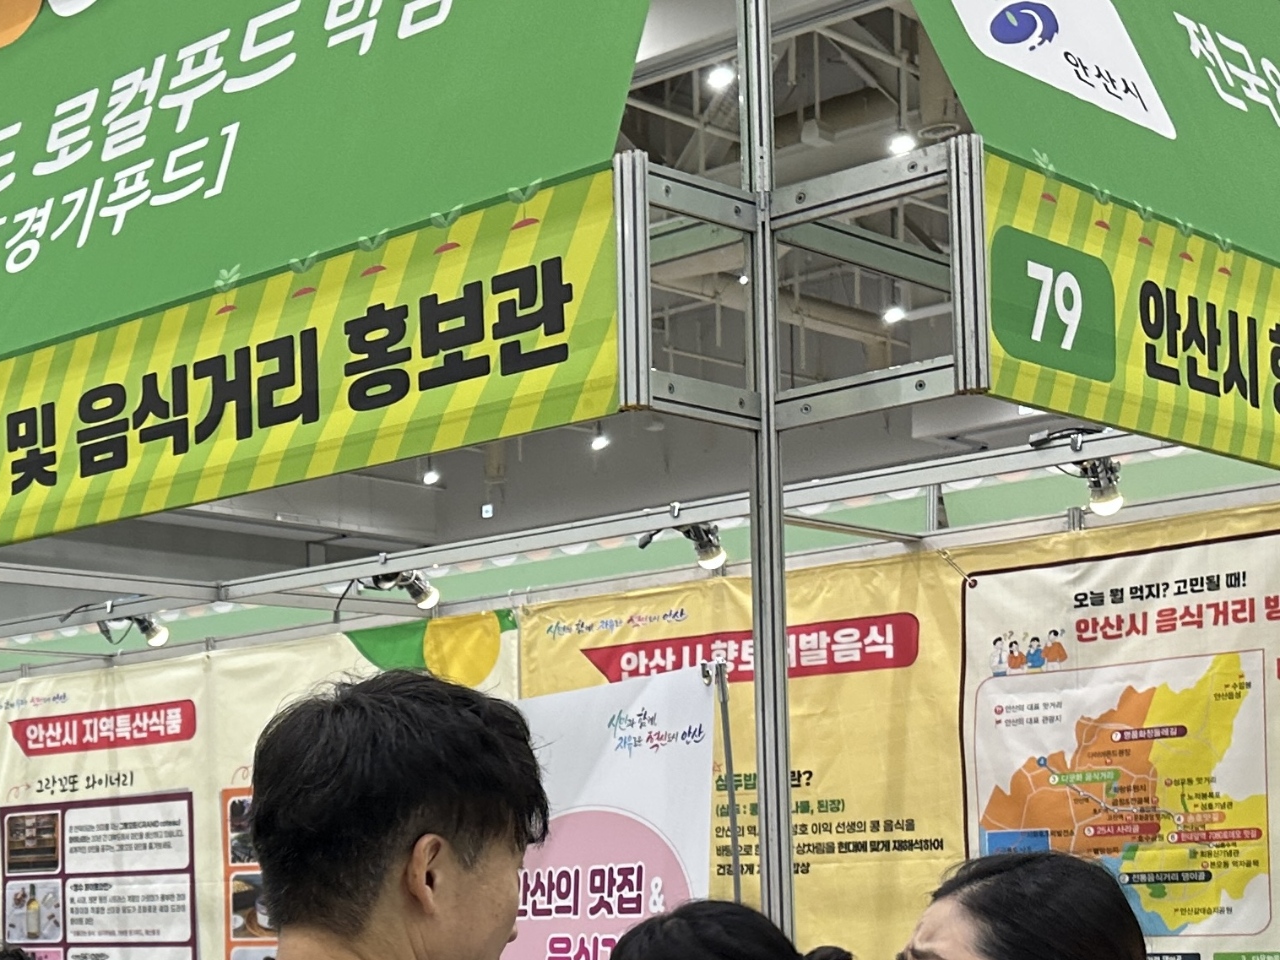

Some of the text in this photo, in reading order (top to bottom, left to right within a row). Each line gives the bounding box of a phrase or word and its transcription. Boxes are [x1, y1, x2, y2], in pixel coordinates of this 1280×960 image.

[33, 0, 300, 178] 로컬푸드
[1063, 51, 1148, 111] 안산시
[1026, 260, 1082, 351] 79
[1139, 279, 1260, 410] 안산시
[5, 412, 57, 500] 및
[73, 328, 319, 481] 음식거리
[341, 259, 575, 415] 홍보관
[1074, 591, 1105, 609] 오늘
[1130, 583, 1169, 601] 먹지?
[1075, 611, 1148, 643] 안산시
[1155, 599, 1255, 634] 음식거리
[26, 708, 182, 750] 안산시 지역특산식품
[35, 771, 135, 796] 그랑꼬또 와이너리
[589, 862, 642, 915] 맛집
[649, 877, 666, 913] &
